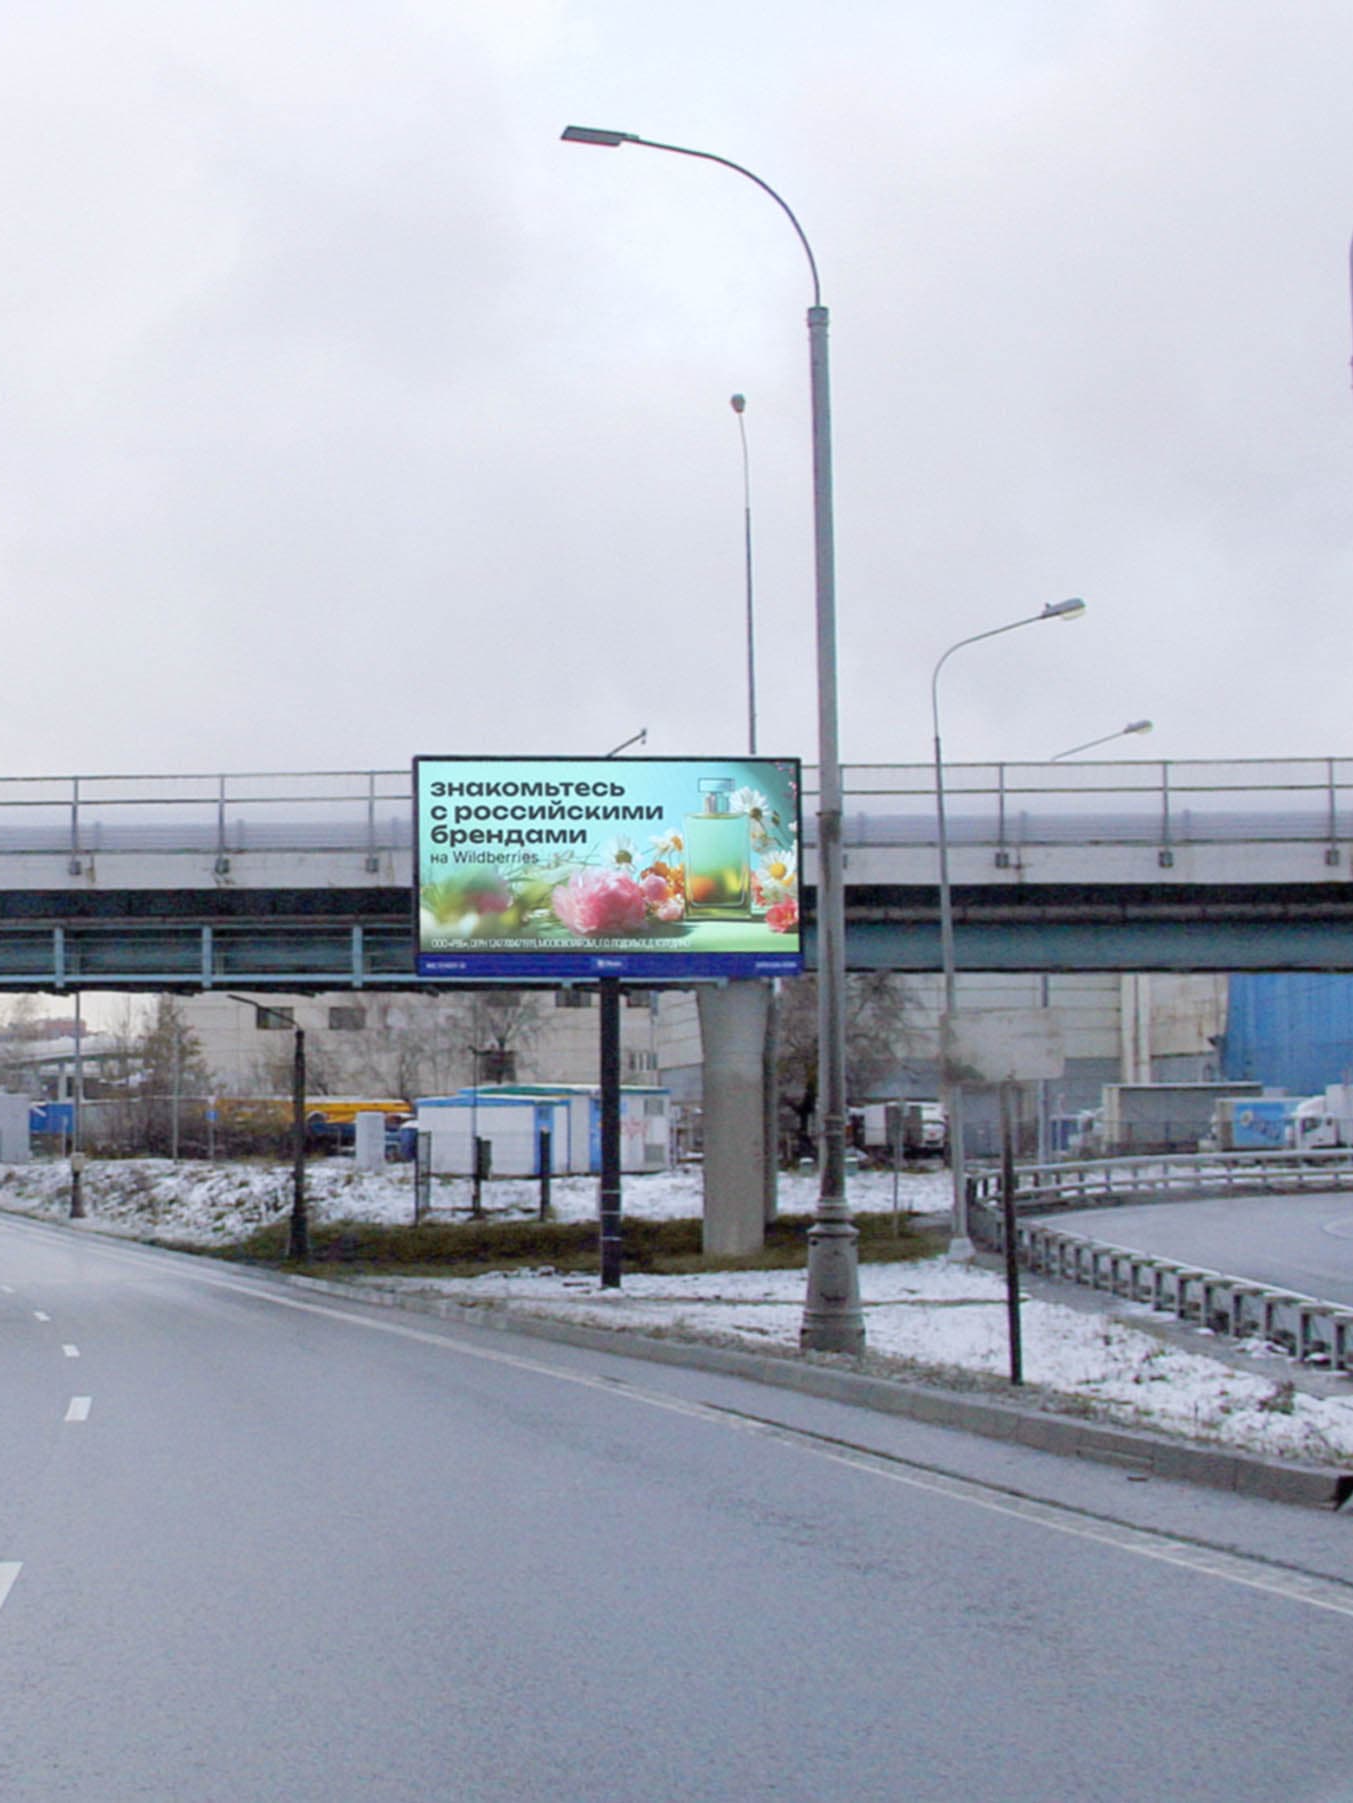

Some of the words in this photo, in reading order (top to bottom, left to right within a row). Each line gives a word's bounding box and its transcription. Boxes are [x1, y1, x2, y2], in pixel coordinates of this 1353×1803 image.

[430, 781, 626, 798] знакомьтесь
[430, 804, 448, 821] с
[454, 800, 664, 824] российскими
[430, 825, 587, 847] брендами
[430, 852, 448, 865] на
[452, 850, 539, 865] Wildberries
